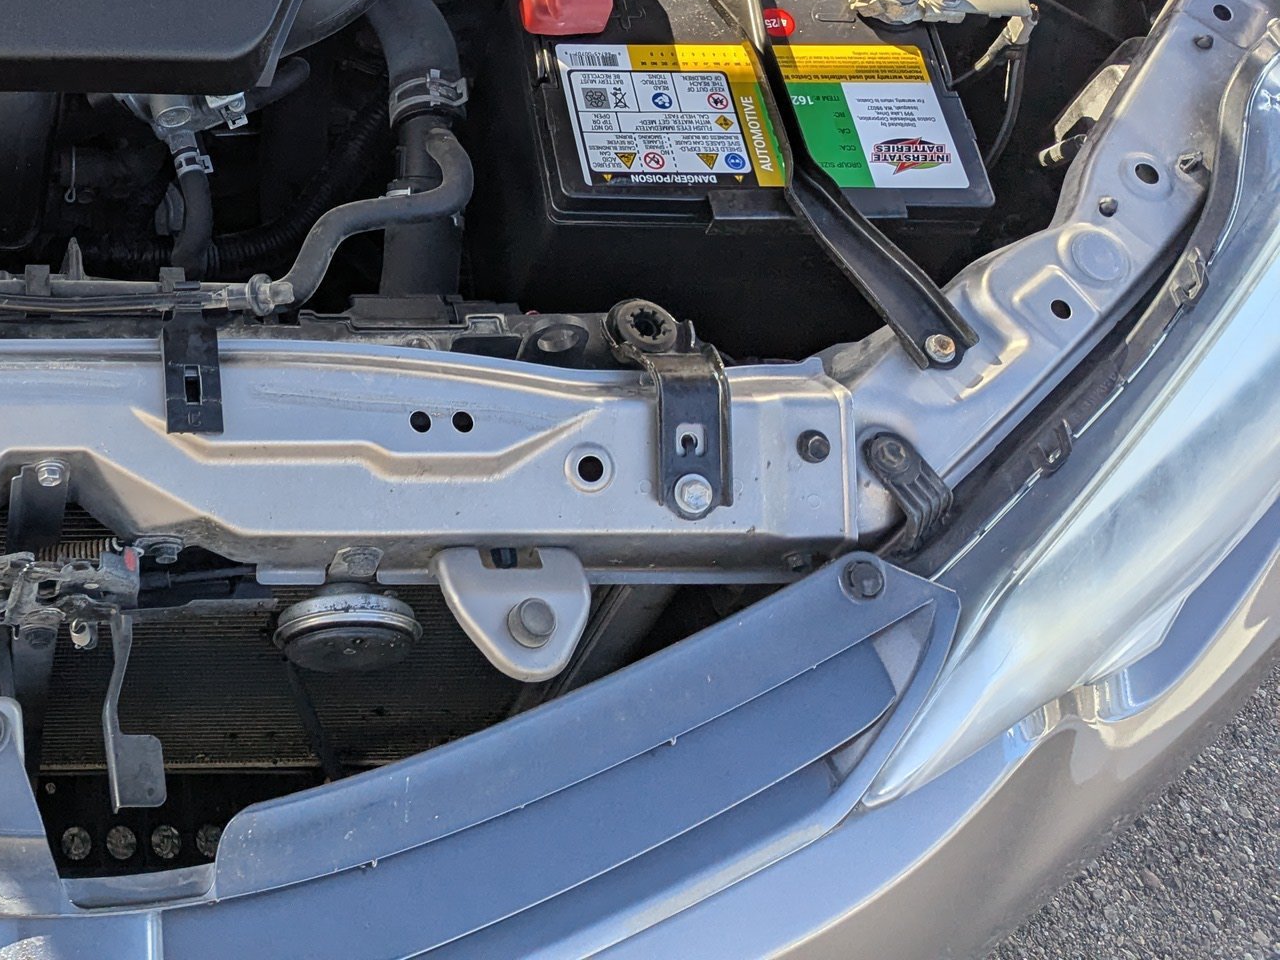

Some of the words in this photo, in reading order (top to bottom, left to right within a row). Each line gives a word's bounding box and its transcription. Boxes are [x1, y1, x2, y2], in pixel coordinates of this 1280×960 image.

[765, 17, 787, 28] 4/25
[740, 95, 774, 172] AUTOMOTIVE
[875, 144, 945, 153] BATTERIES
[873, 153, 950, 162] INTERSTATE
[630, 174, 718, 184] DANGER/POISON
